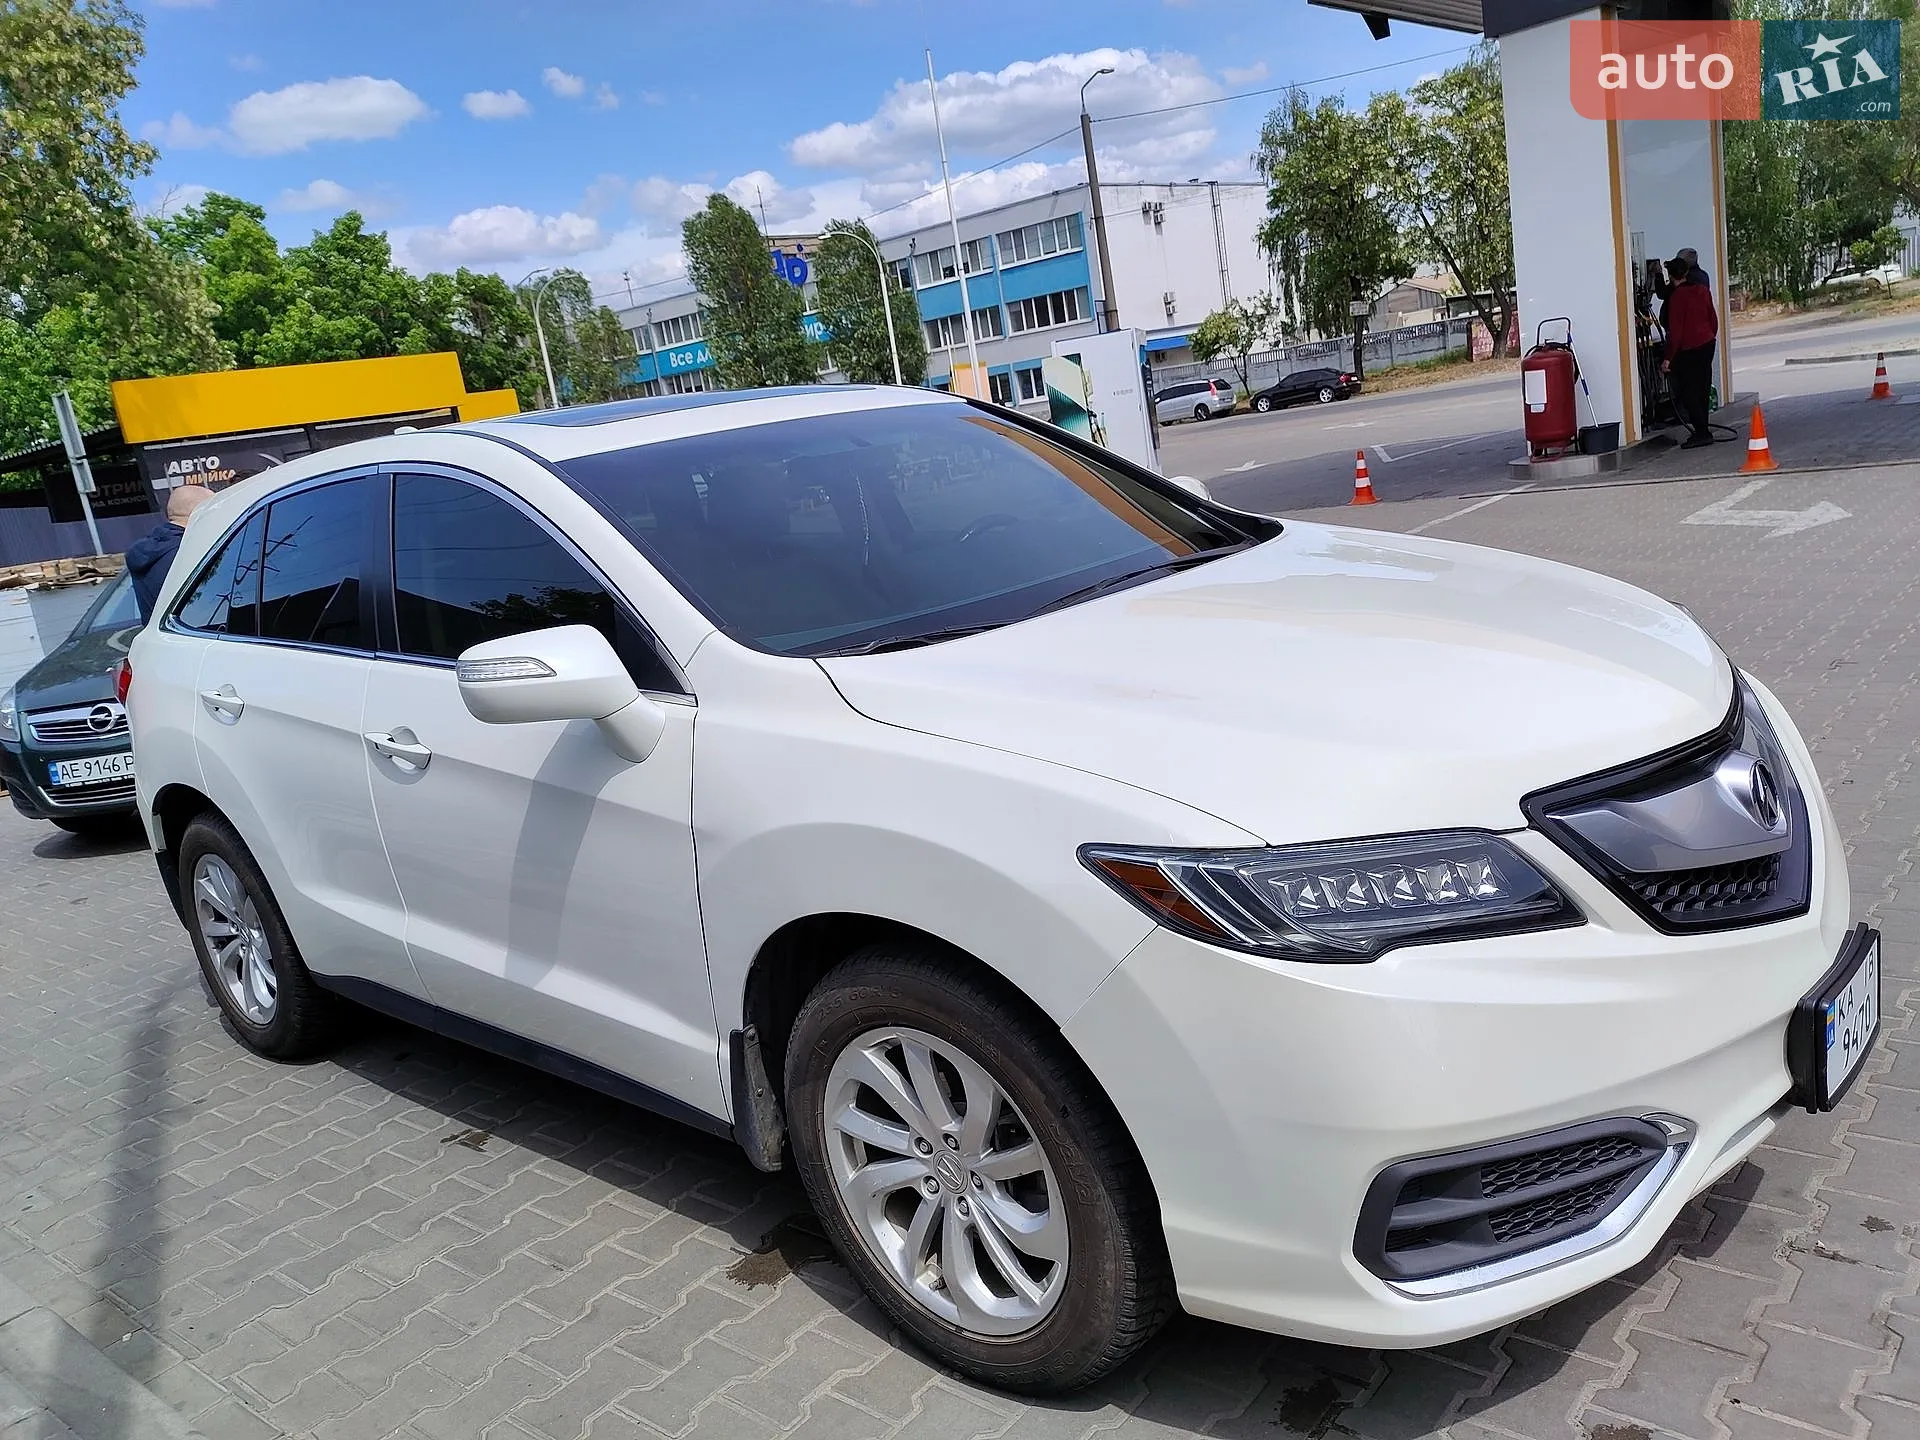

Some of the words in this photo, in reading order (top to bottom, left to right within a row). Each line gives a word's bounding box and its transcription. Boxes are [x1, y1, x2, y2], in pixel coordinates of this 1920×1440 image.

[669, 351, 694, 368] Все
[697, 348, 714, 364] дл
[167, 456, 220, 475] АВТО
[61, 763, 82, 780] AE
[84, 757, 121, 776] 9146
[123, 755, 134, 770] P
[1838, 984, 1854, 1026] KA
[1843, 993, 1871, 1071] 9470
